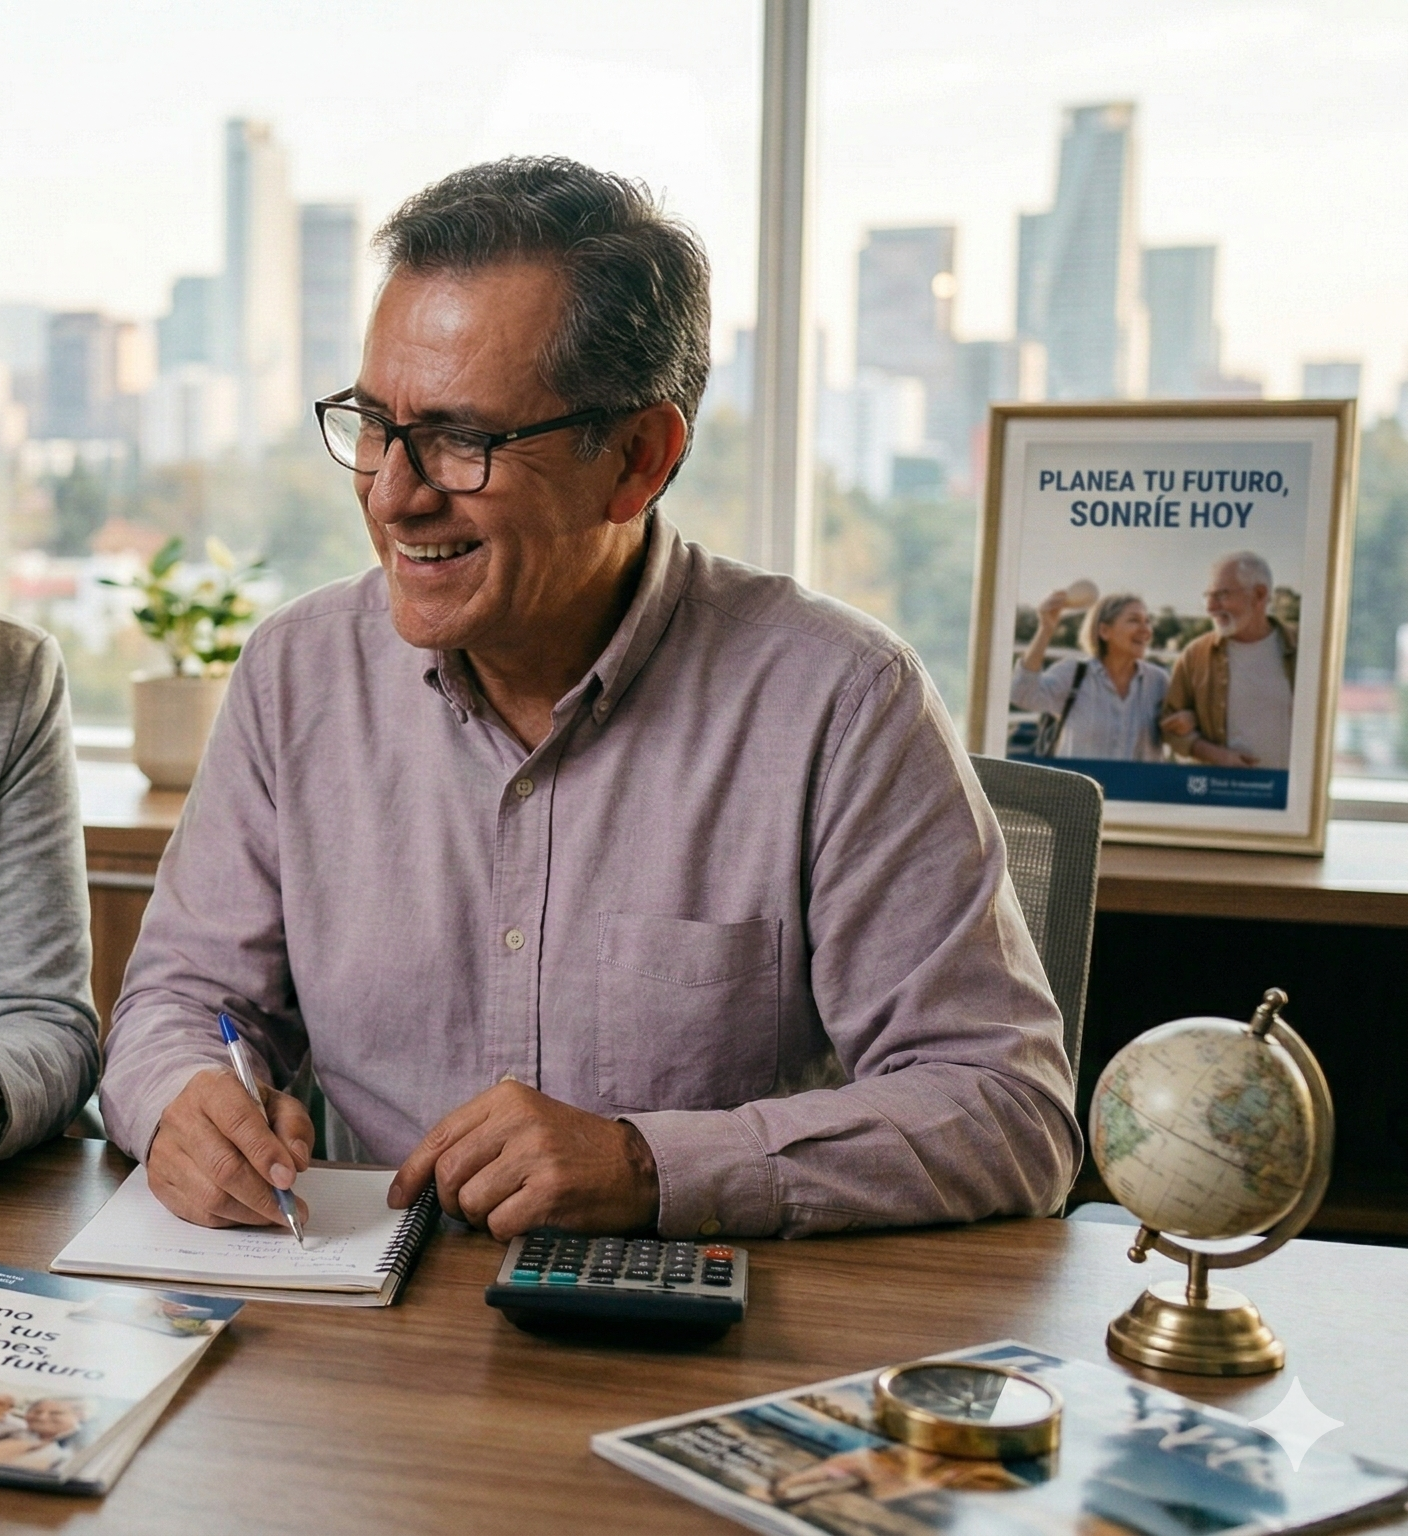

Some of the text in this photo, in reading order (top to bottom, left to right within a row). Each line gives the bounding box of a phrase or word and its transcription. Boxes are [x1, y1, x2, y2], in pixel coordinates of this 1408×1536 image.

[1039, 470, 1289, 498] PLANEA TU FUTURO,
[1070, 496, 1254, 528] SONRÍE HOY
[10, 1325, 60, 1342] tus
[0, 1354, 105, 1380] futuro
